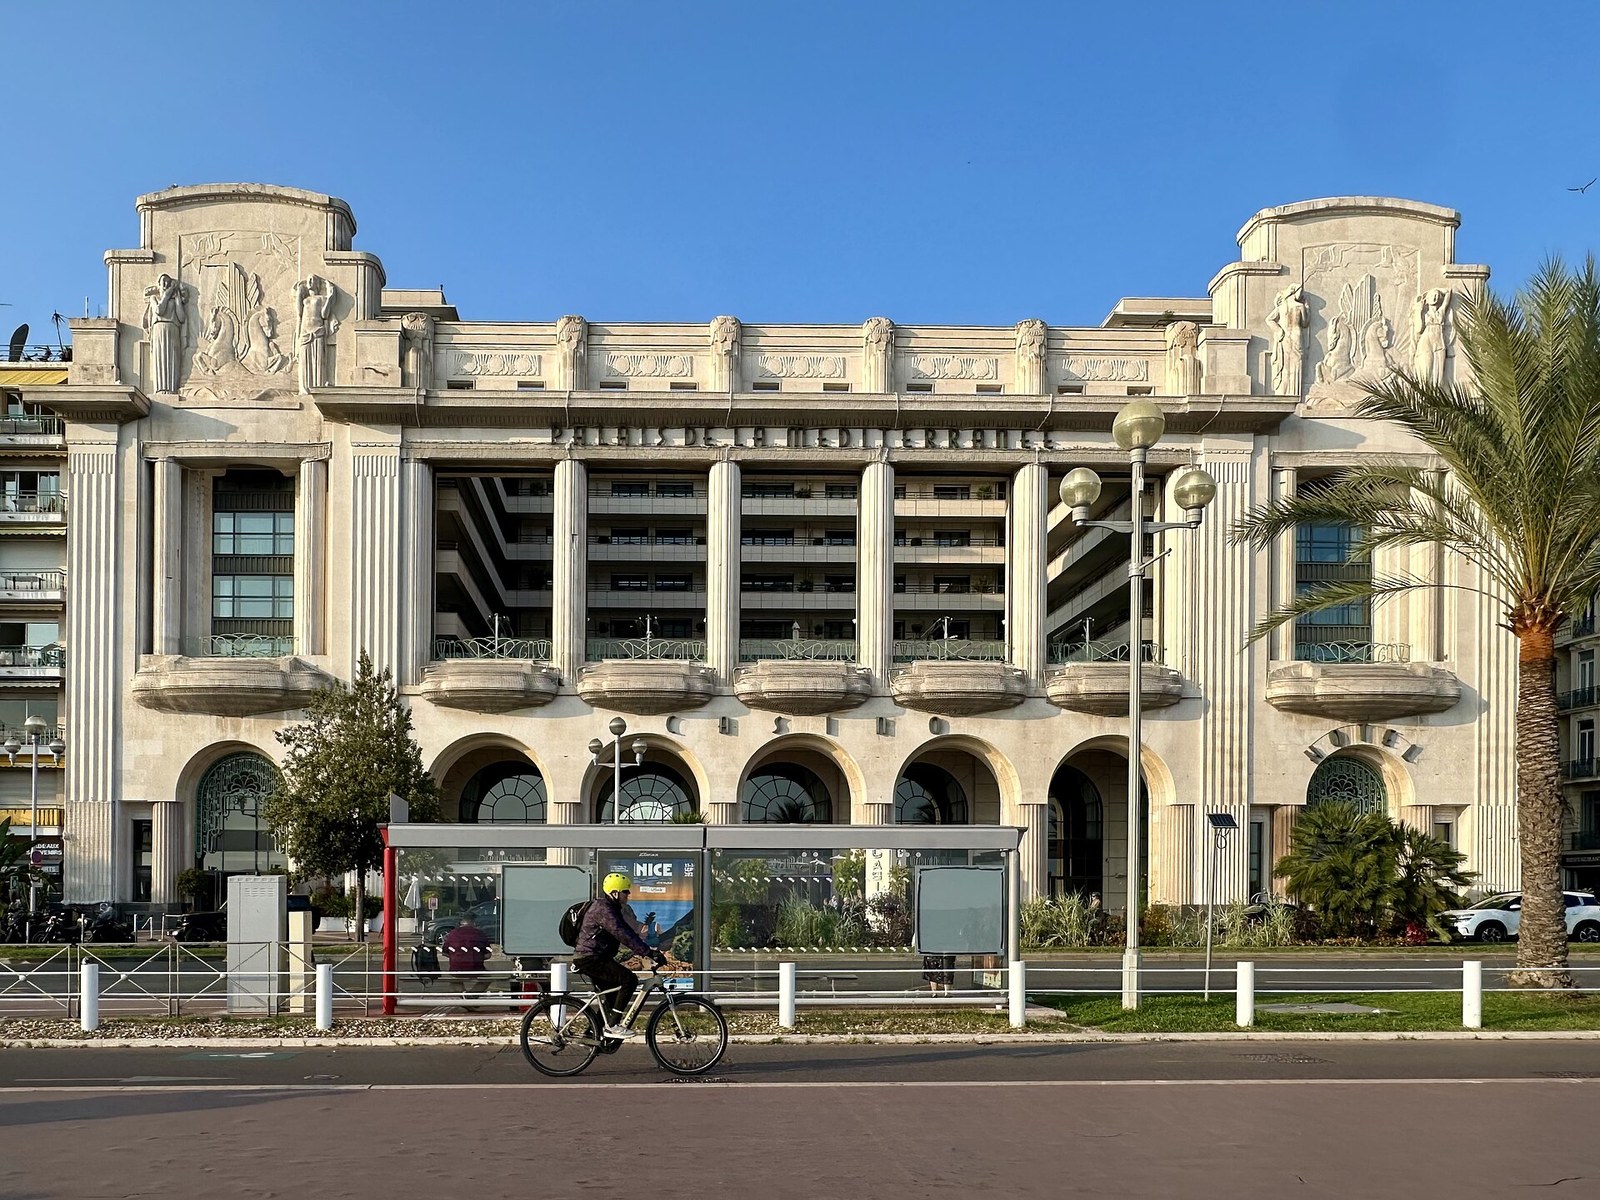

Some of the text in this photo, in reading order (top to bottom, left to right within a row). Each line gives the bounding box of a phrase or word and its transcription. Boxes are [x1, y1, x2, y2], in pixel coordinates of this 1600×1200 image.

[552, 426, 667, 446] PALAIS
[685, 428, 713, 447] DE
[734, 428, 766, 448] LA
[1303, 723, 1418, 765] HOTEL
[634, 863, 673, 877] NICE
